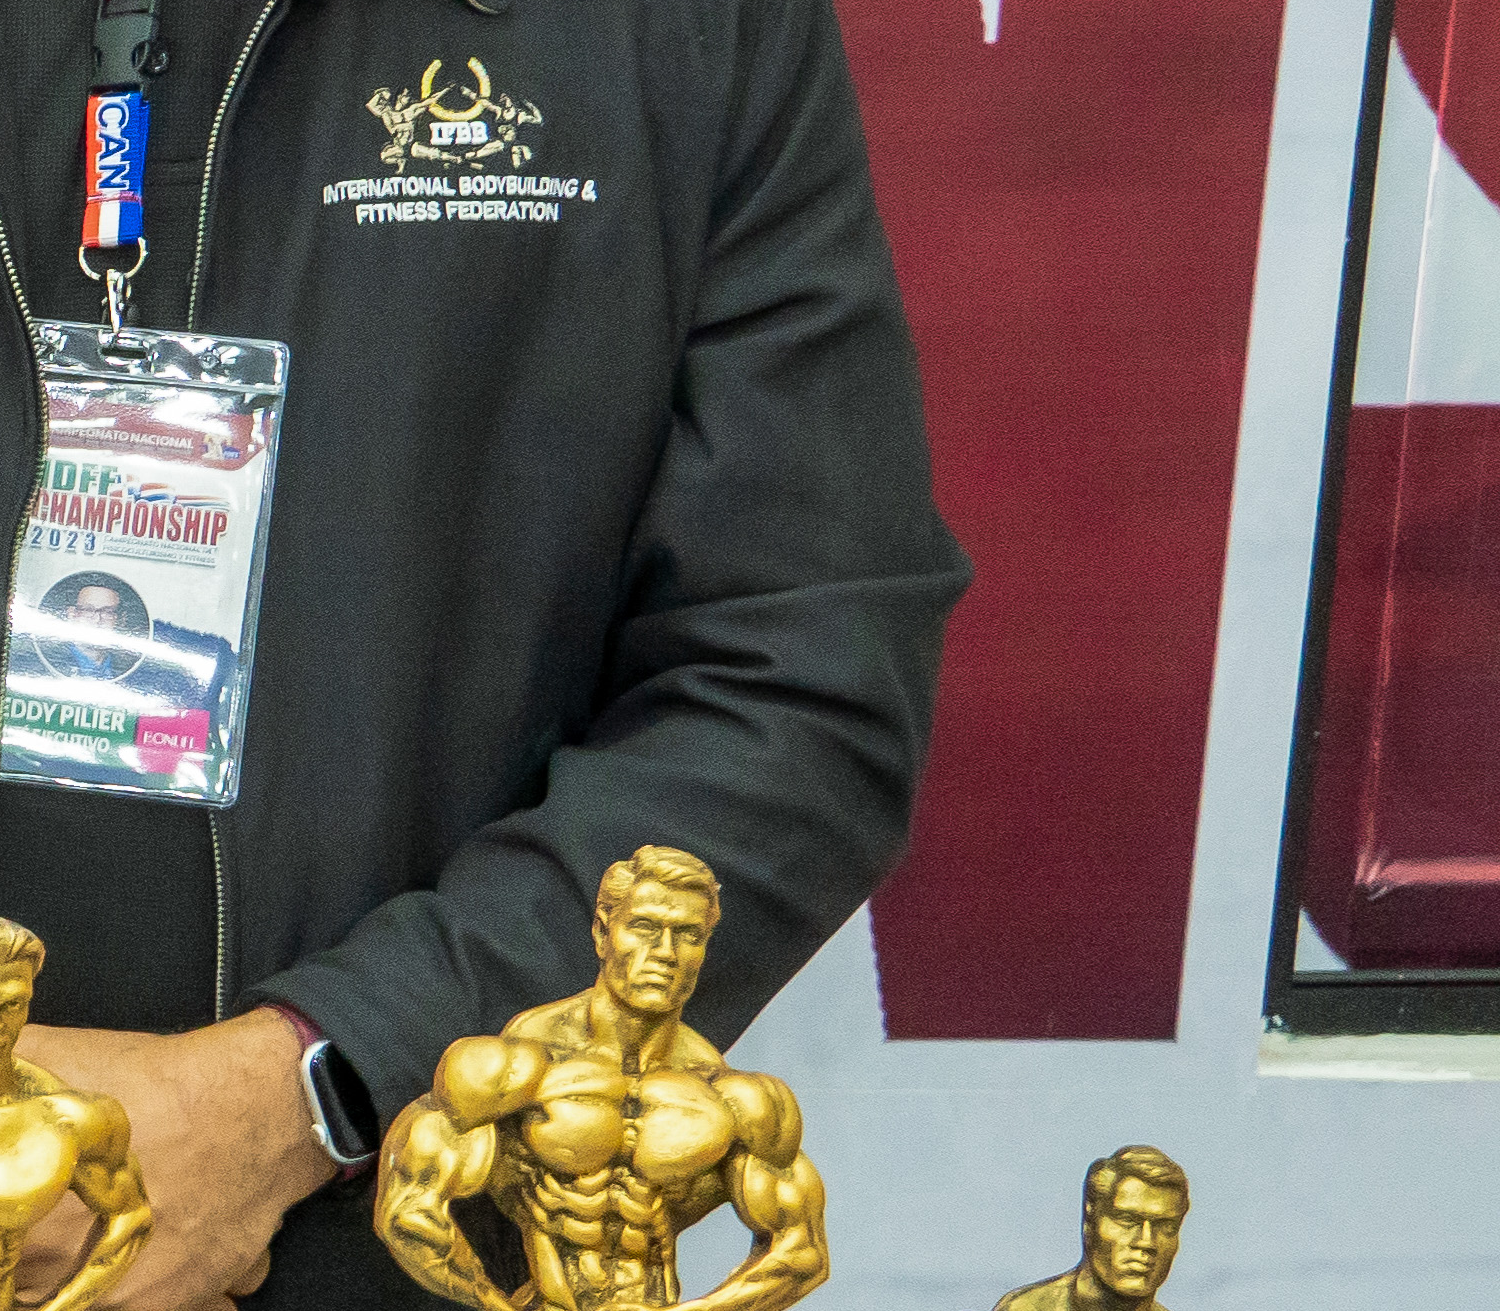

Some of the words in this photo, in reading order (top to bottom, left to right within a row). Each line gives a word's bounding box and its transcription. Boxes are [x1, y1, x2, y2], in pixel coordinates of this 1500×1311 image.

[430, 121, 488, 145] IFBB
[323, 176, 456, 204] INTERNATIONAL
[459, 176, 579, 197] BODYBUILDING
[582, 180, 597, 202] &
[356, 201, 441, 224] FITNESS
[446, 200, 561, 222] FEDERATION
[131, 431, 194, 450] NACIONAL
[34, 489, 228, 546] CHAMPIONSHIP
[30, 525, 96, 551] 2023
[59, 706, 126, 733] PILIER
